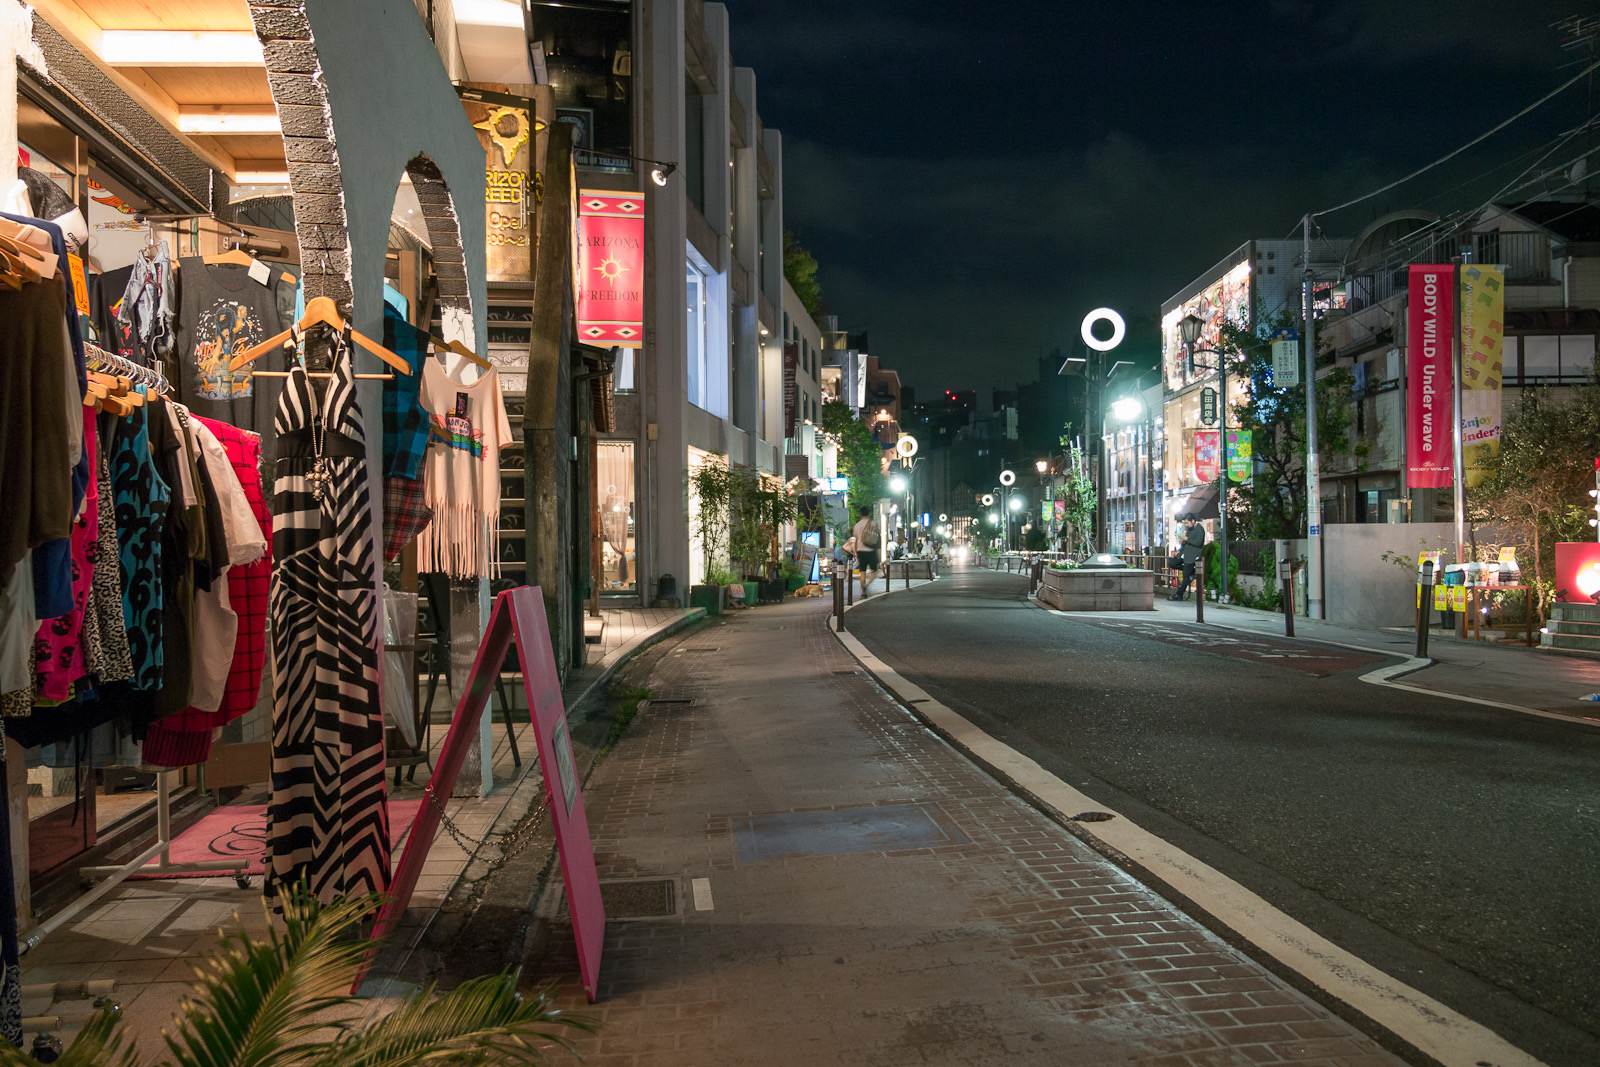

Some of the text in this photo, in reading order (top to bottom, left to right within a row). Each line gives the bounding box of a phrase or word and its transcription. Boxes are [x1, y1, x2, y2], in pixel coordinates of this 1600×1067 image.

[587, 236, 640, 249] ARIZONA
[585, 290, 639, 302] FREEDOM
[1424, 274, 1436, 315] BODY
[1424, 319, 1436, 358] WILD
[1464, 281, 1473, 378] www.bodywild.com
[1423, 365, 1436, 408] Under
[1422, 409, 1433, 452] wave
[1462, 416, 1492, 429] Enjoy
[1463, 425, 1500, 442] Under?
